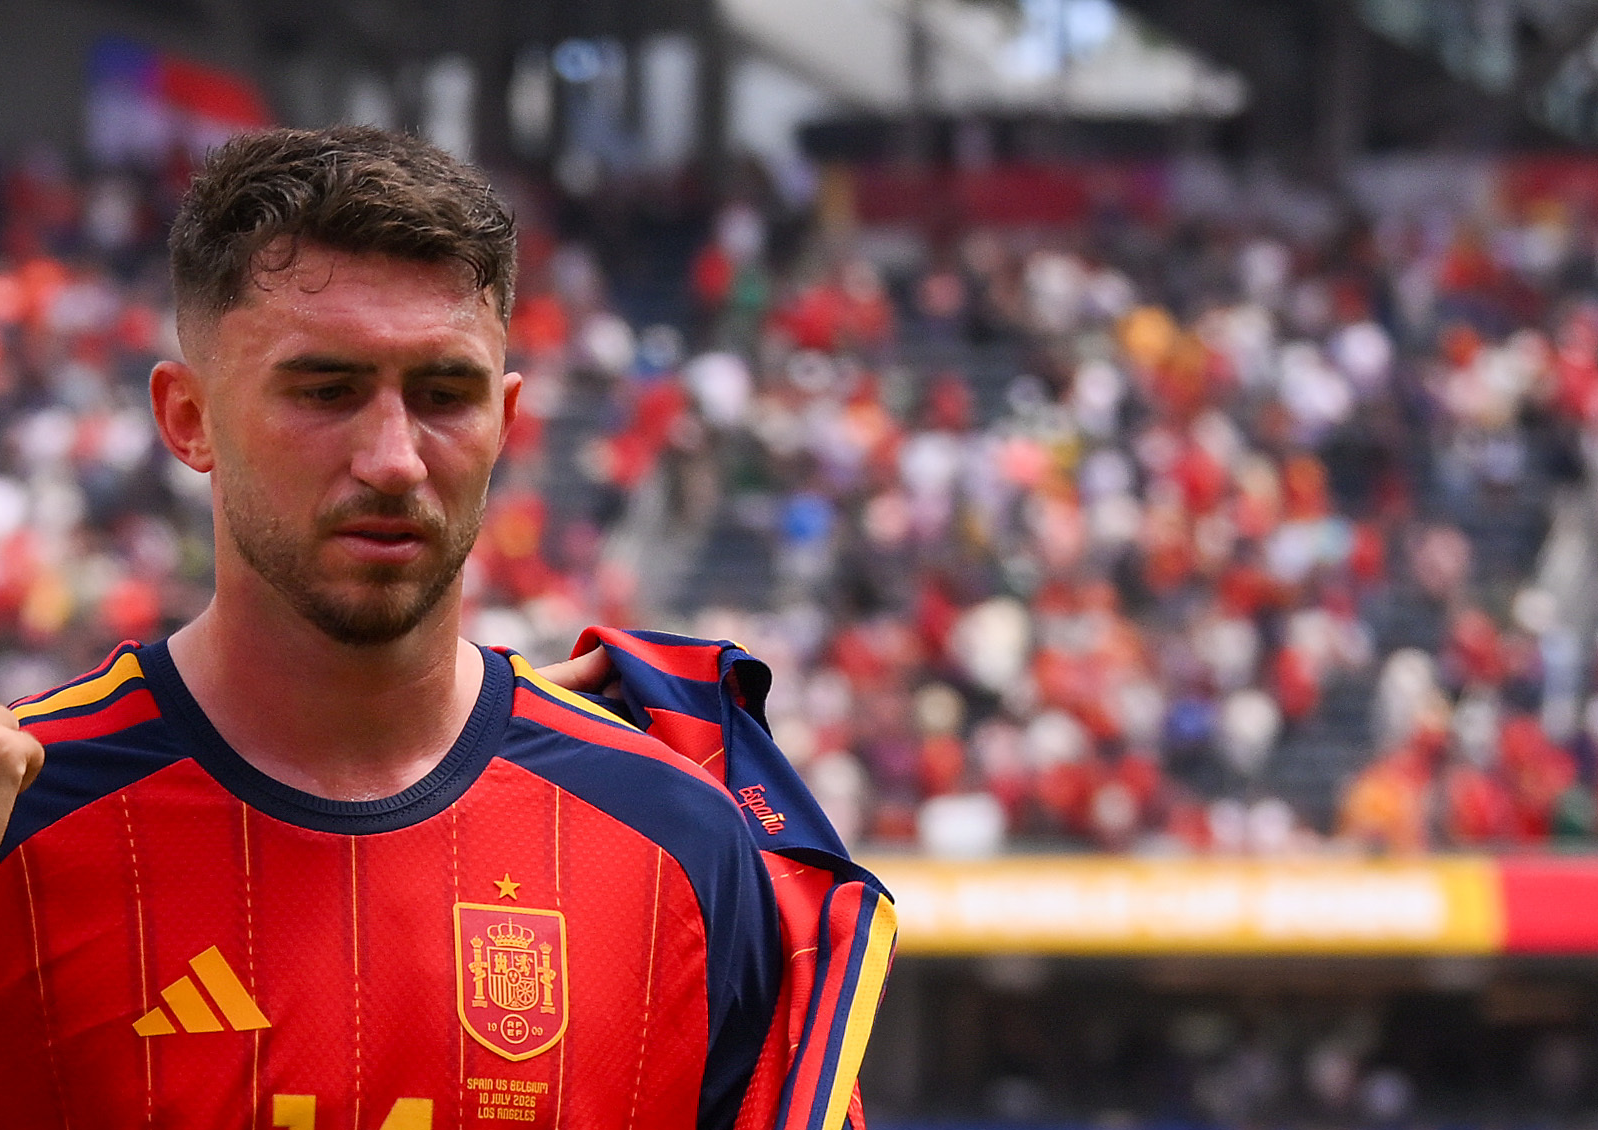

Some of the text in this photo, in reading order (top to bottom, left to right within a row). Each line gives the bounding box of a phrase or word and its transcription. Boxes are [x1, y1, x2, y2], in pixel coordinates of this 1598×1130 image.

[738, 783, 786, 835] España
[467, 1078, 493, 1090] SPAIN
[510, 1080, 548, 1094] BELGIUM
[479, 1092, 536, 1107] 10 JULY 2026
[477, 1106, 536, 1121] LOS ANGELES
